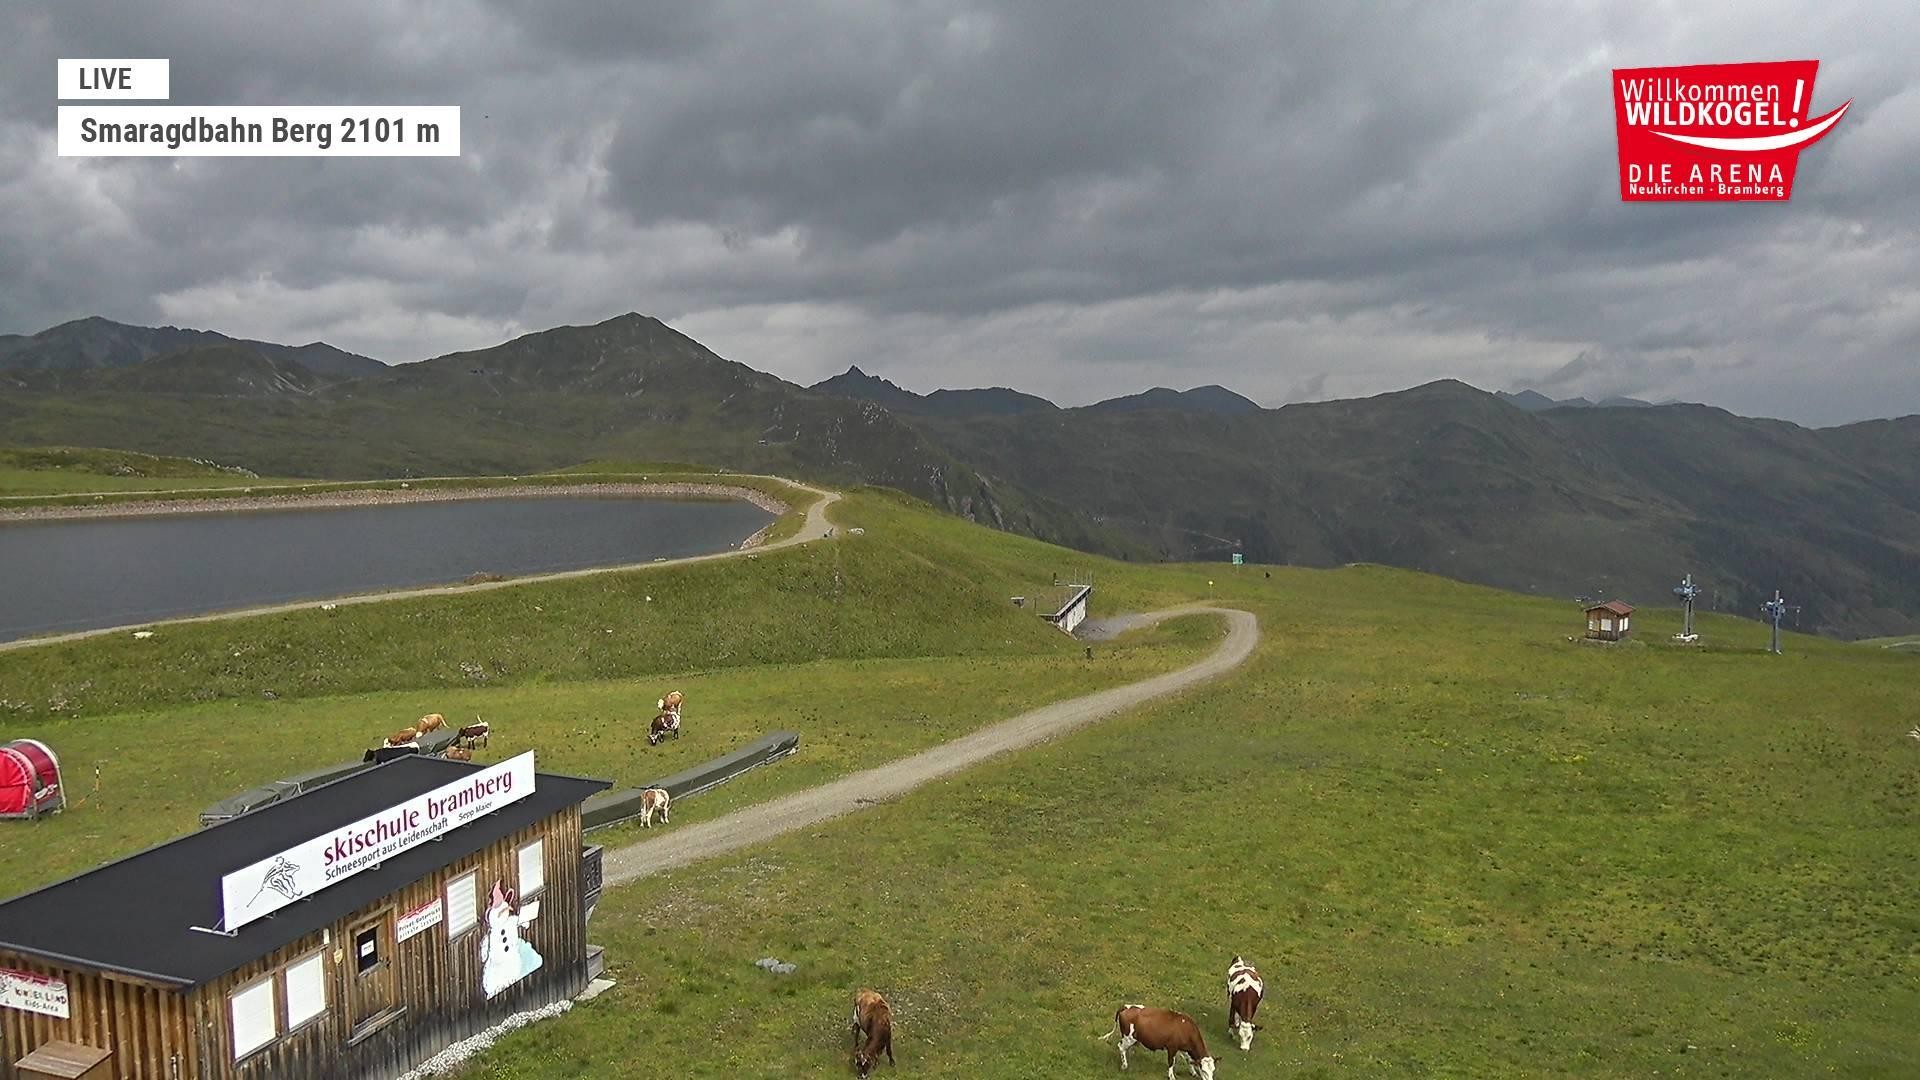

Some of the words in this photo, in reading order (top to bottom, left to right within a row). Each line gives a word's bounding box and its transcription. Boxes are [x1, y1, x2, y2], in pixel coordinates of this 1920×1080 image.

[324, 809, 419, 866] skischule
[428, 771, 512, 820] bramberg
[458, 810, 475, 821] Sepp
[475, 801, 493, 813] Maier
[325, 848, 380, 881] Schneesport
[382, 842, 397, 855] aus
[399, 817, 448, 848] Leidenschaft
